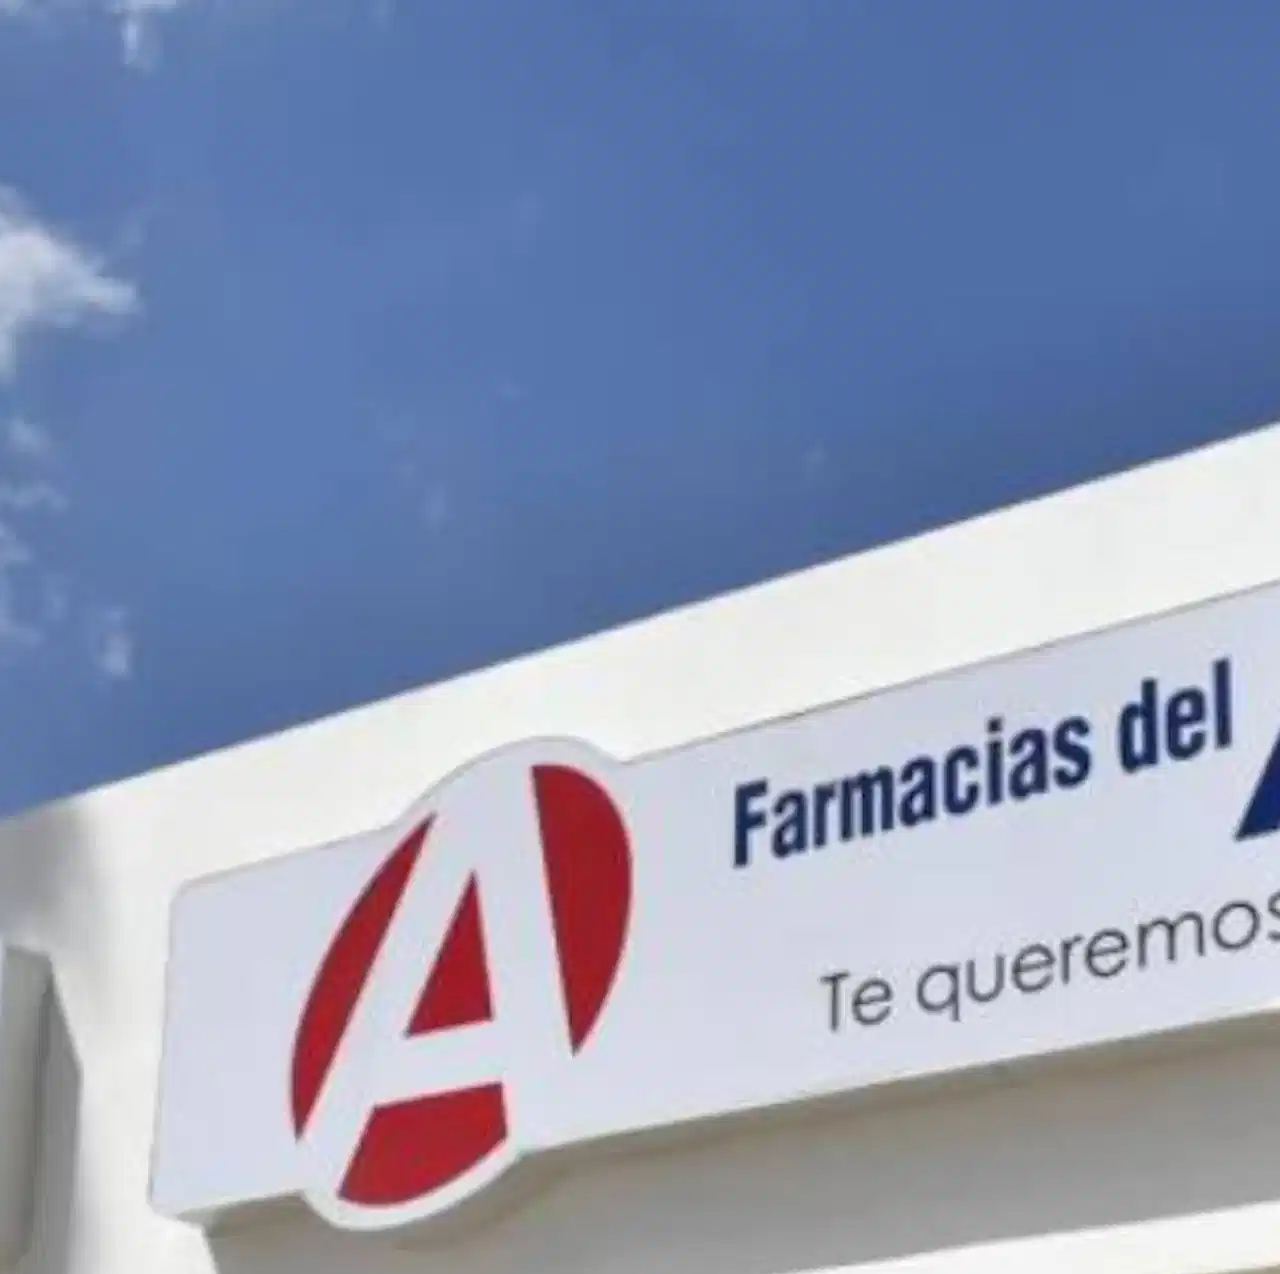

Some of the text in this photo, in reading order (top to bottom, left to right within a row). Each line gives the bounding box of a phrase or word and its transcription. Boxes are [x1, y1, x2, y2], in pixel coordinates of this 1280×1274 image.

[732, 715, 1093, 869] Farmacias
[1117, 655, 1235, 775] del
[820, 970, 894, 1033] Te
